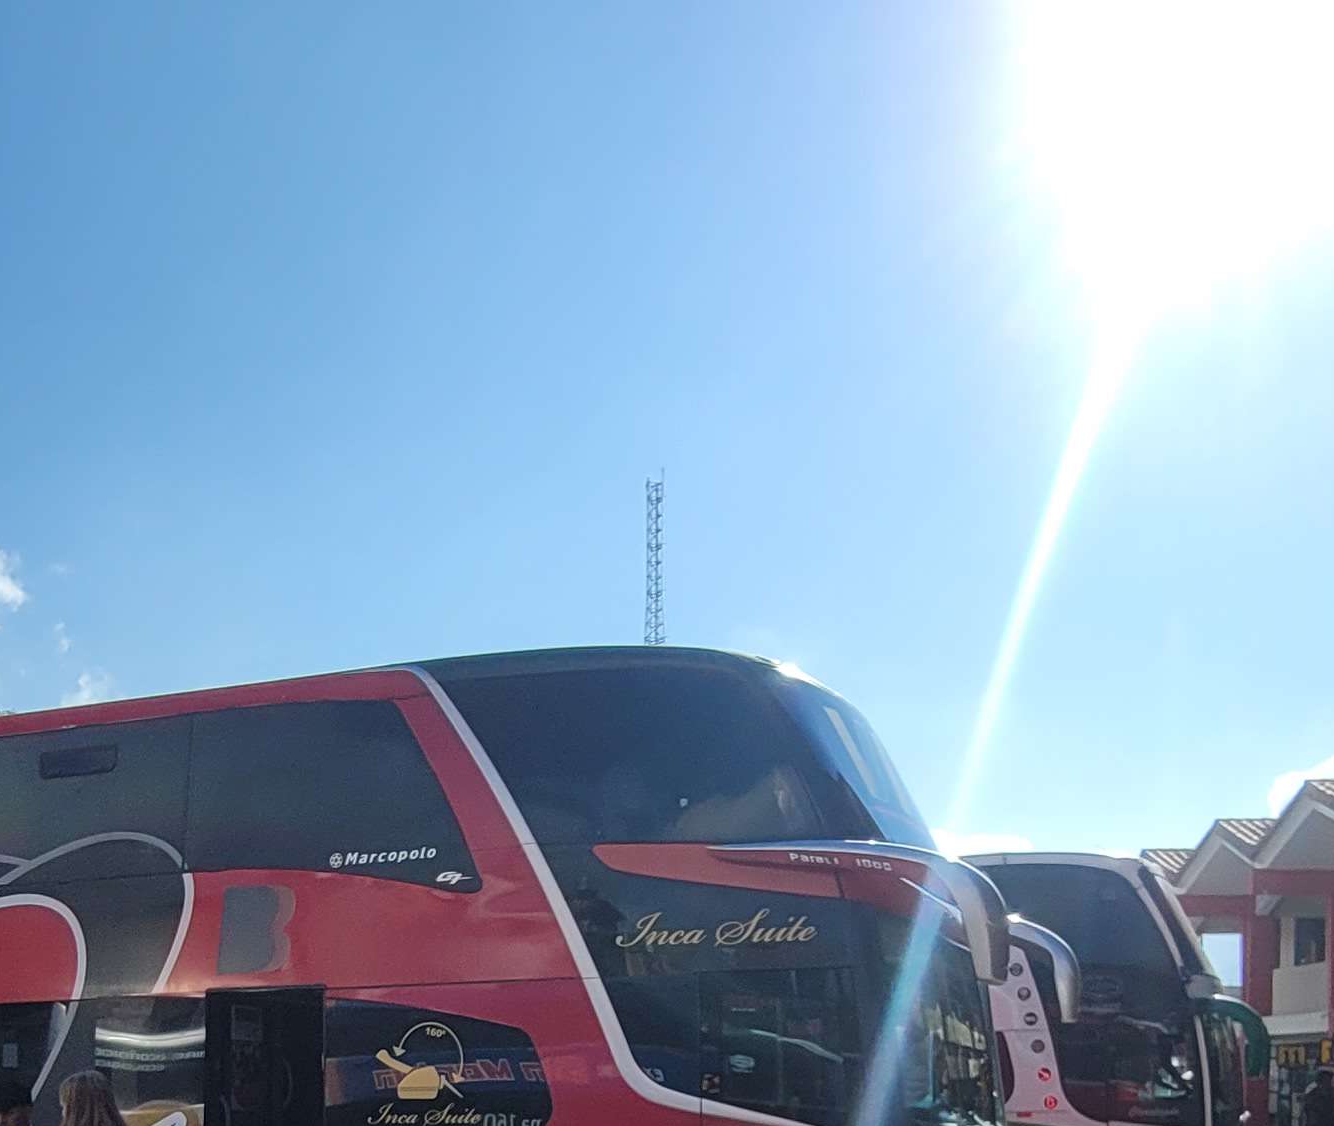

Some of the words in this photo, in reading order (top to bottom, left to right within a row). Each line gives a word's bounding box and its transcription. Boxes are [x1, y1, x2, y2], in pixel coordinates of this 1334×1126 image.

[344, 846, 437, 866] Marcopolo
[615, 911, 707, 948] Inca
[714, 908, 818, 947] Suite
[367, 1102, 418, 1125] Inca
